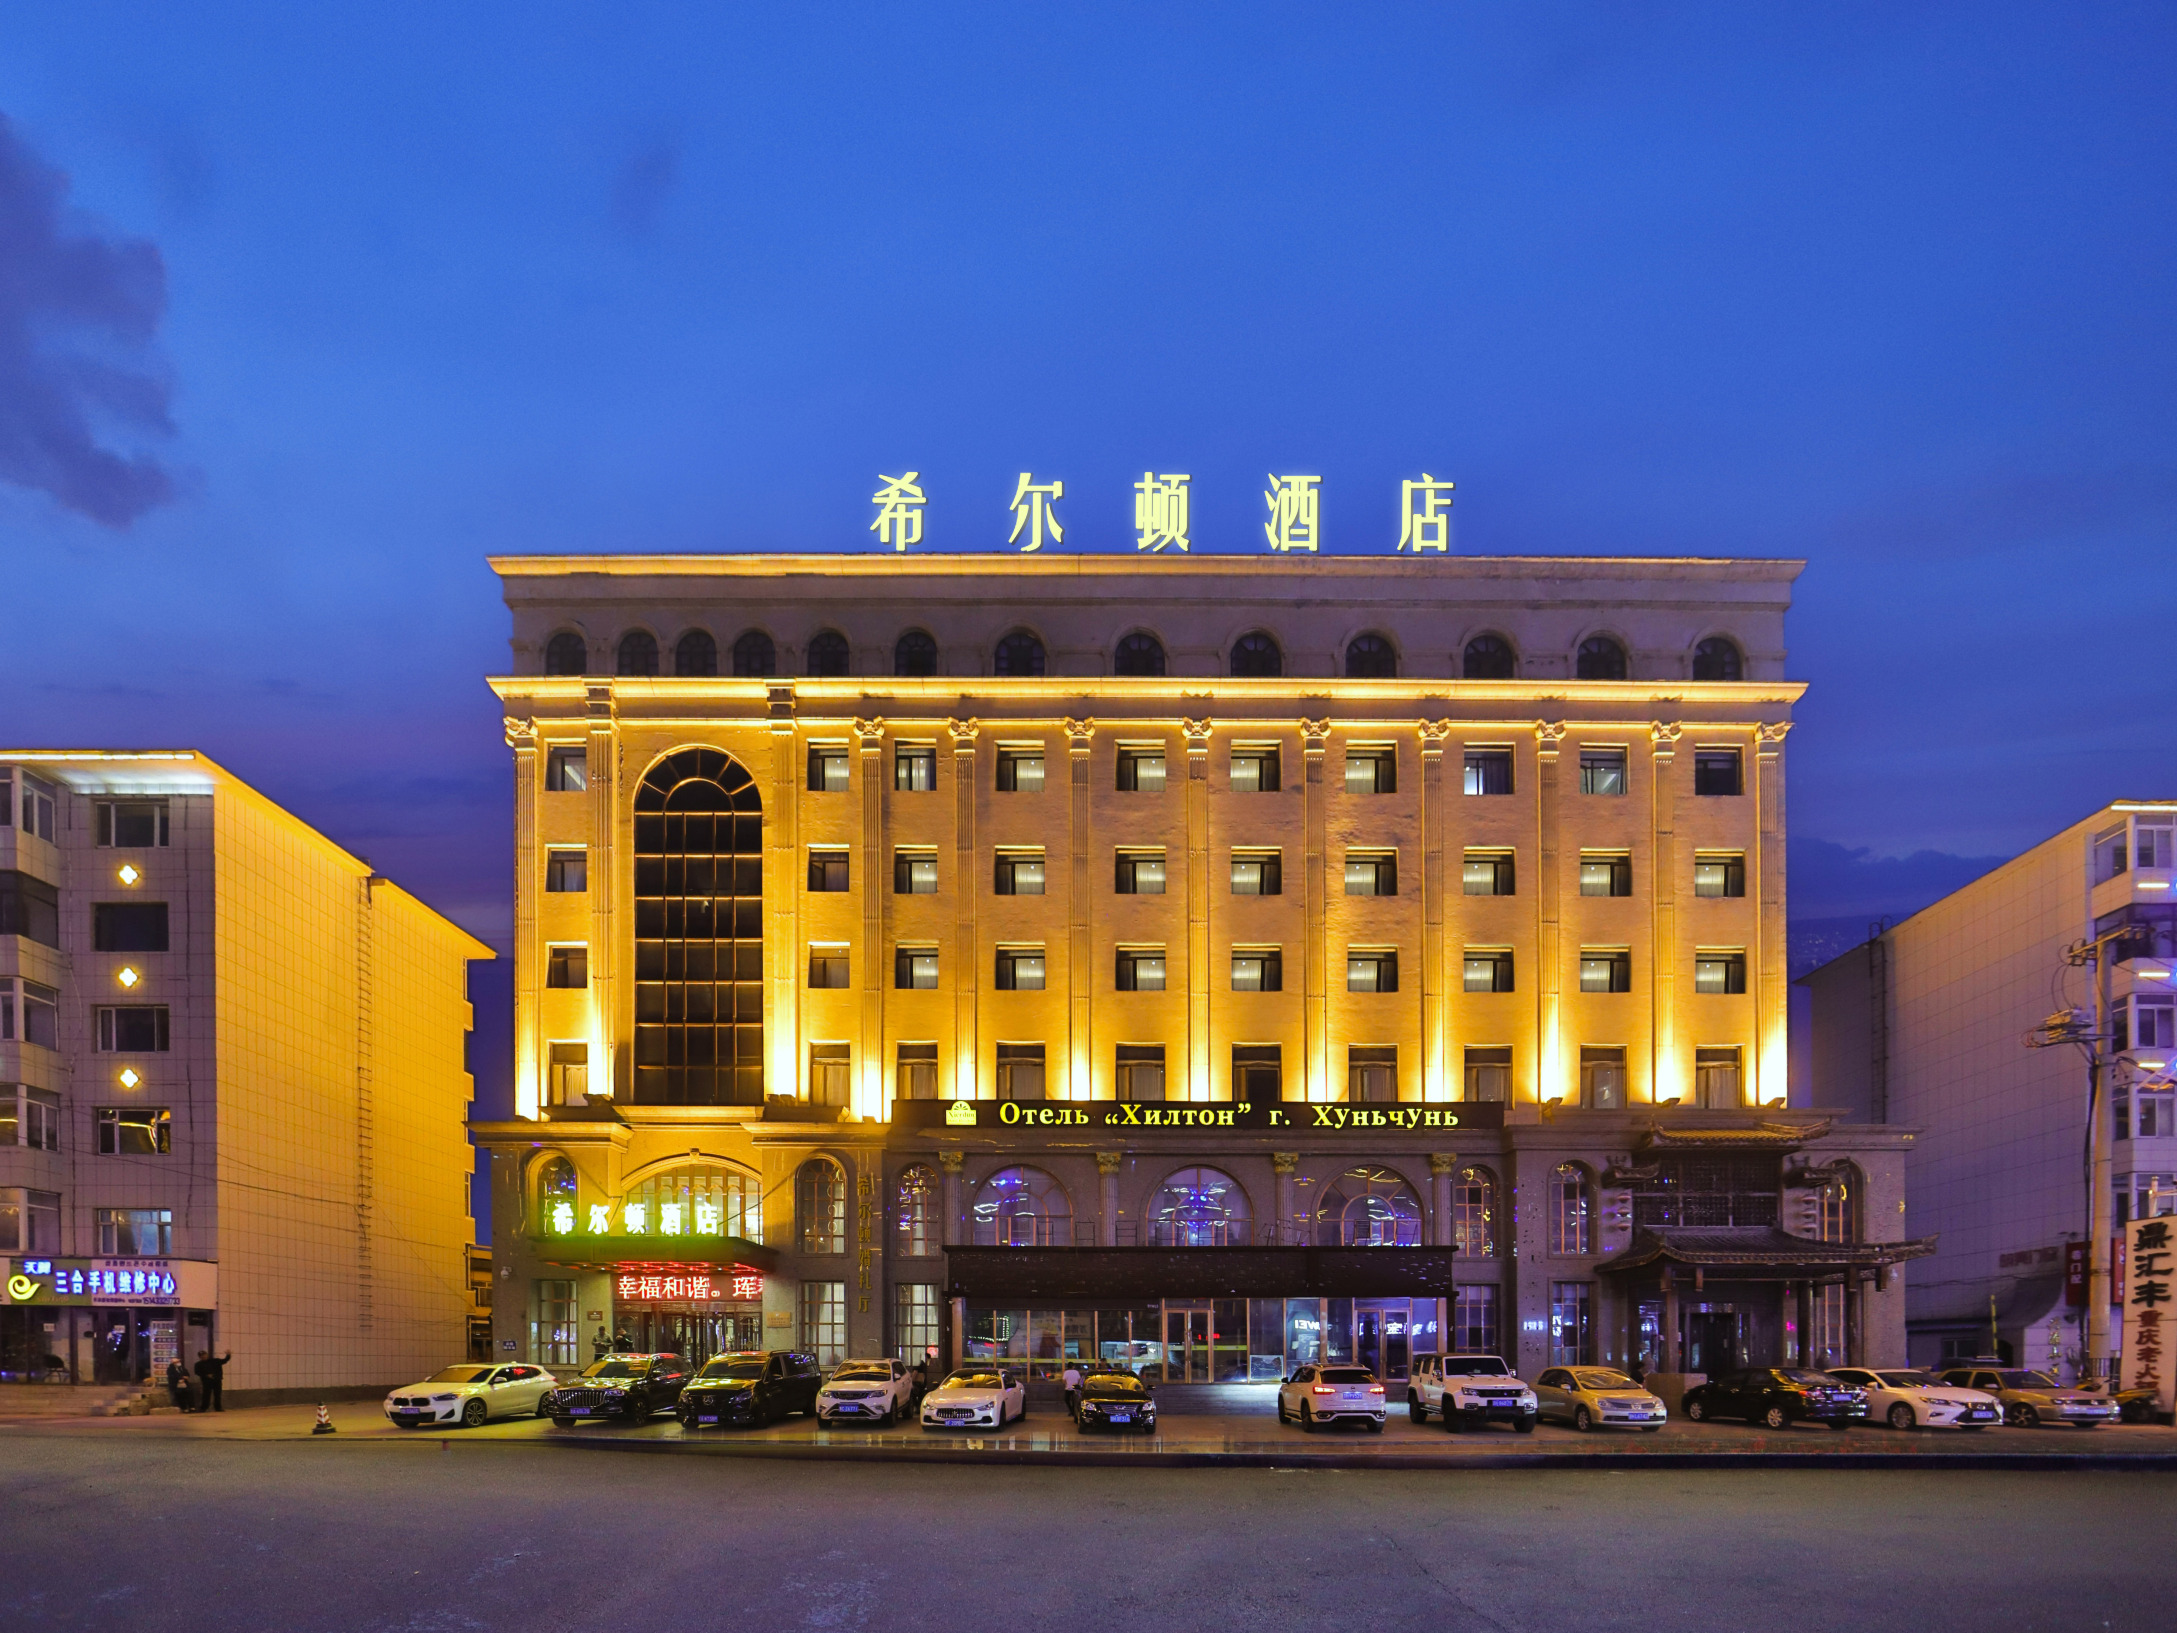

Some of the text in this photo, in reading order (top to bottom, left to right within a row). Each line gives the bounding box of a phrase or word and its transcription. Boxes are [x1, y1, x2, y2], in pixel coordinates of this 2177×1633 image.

[870, 471, 1455, 552] 希尔顿酒店
[999, 1102, 1089, 1125] Отель
[1268, 1109, 1291, 1126] г.
[552, 1202, 718, 1235] 希尔顿酒店
[857, 1176, 873, 1314] 希尔顿婚礼厅
[55, 1268, 176, 1295] 三合手机维修中心
[2131, 1221, 2175, 1308] 鼎汇丰
